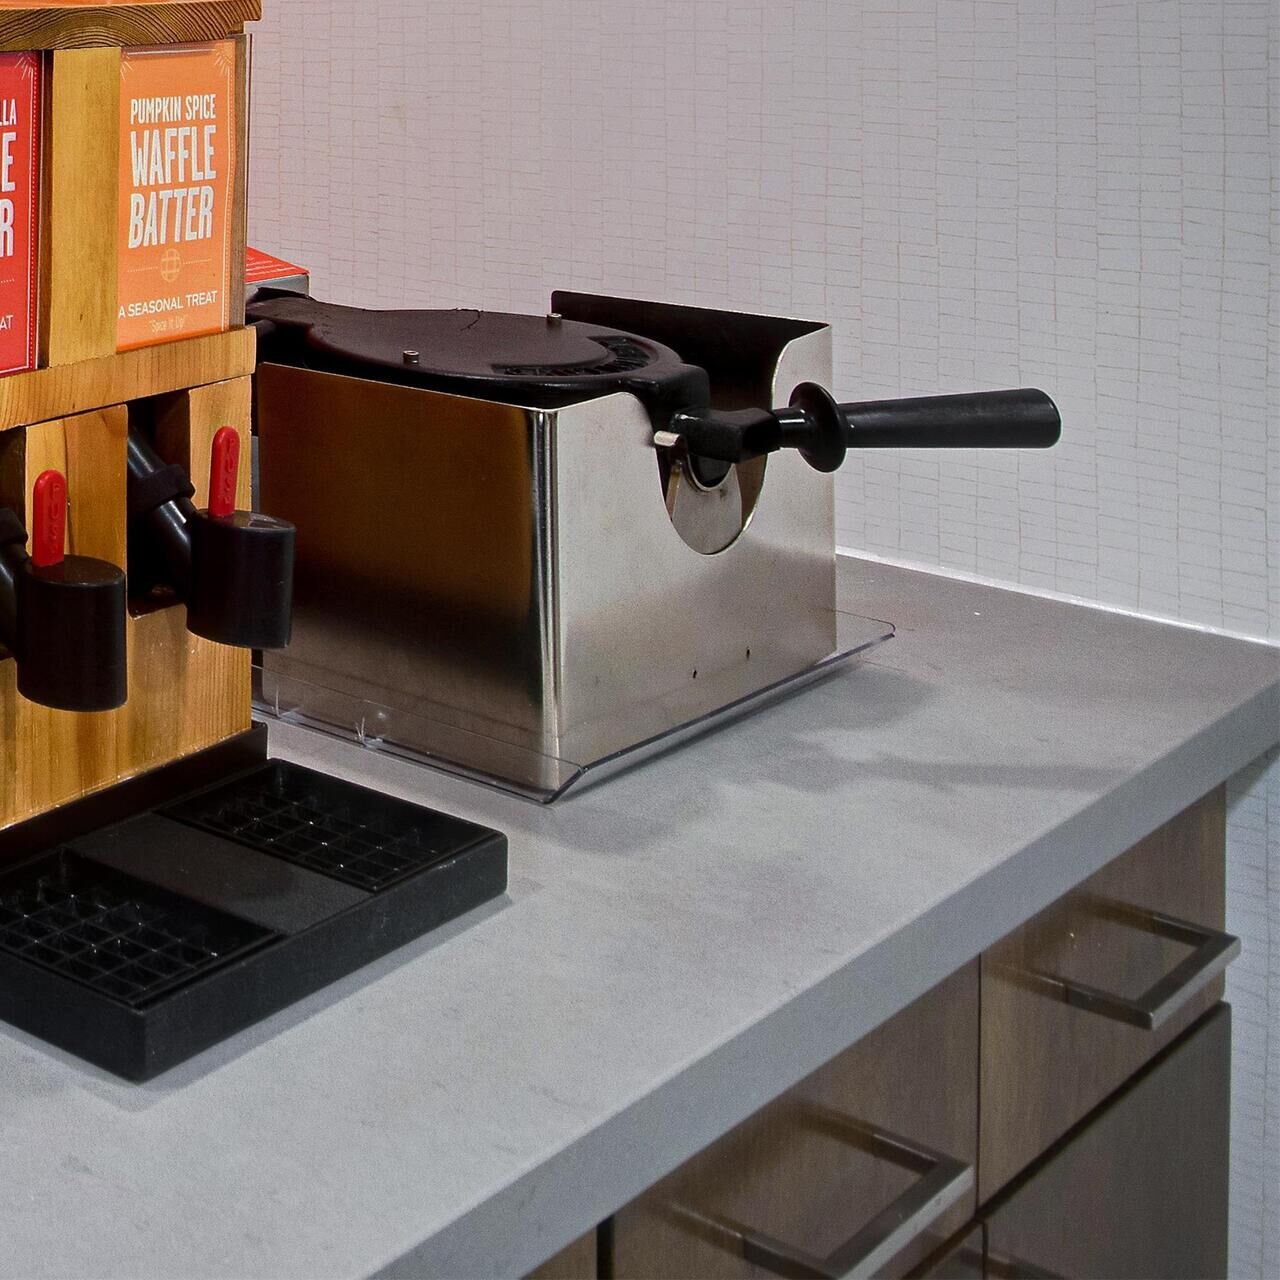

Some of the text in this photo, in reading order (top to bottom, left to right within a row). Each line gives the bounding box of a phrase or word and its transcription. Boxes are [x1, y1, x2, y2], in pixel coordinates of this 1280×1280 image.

[130, 94, 217, 125] PUMPKIN SPICE
[130, 124, 217, 186] WAFFLE
[128, 185, 214, 250] BATTER
[118, 290, 218, 319] A SEASONAL TREAT
